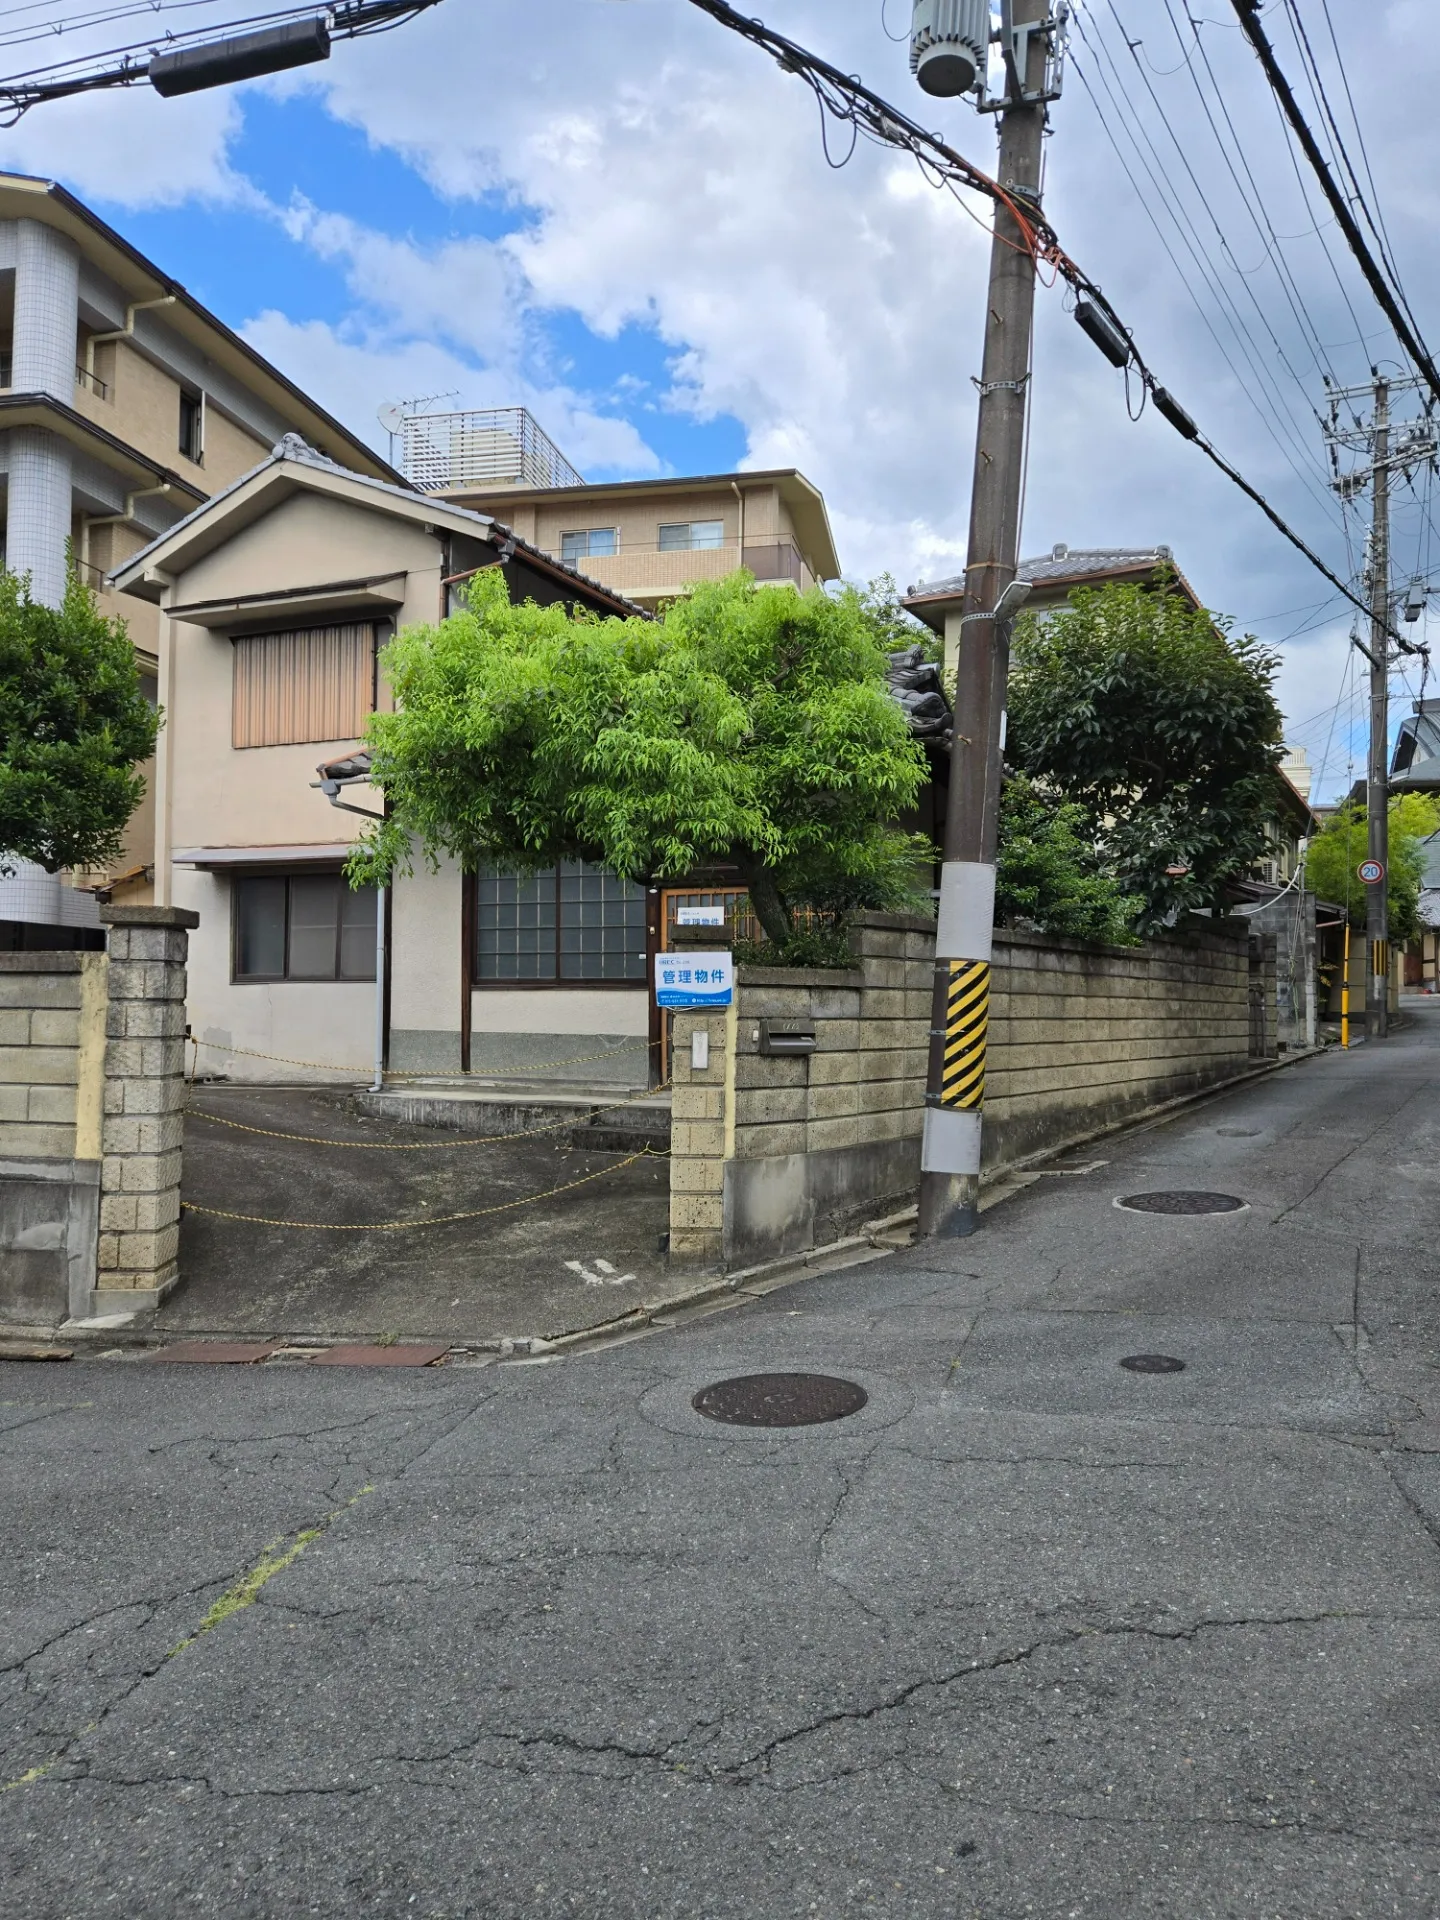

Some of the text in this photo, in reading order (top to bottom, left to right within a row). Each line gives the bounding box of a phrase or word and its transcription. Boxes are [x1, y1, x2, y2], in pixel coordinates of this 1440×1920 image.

[1363, 866, 1378, 877] 20
[663, 969, 724, 984] 管理物件
